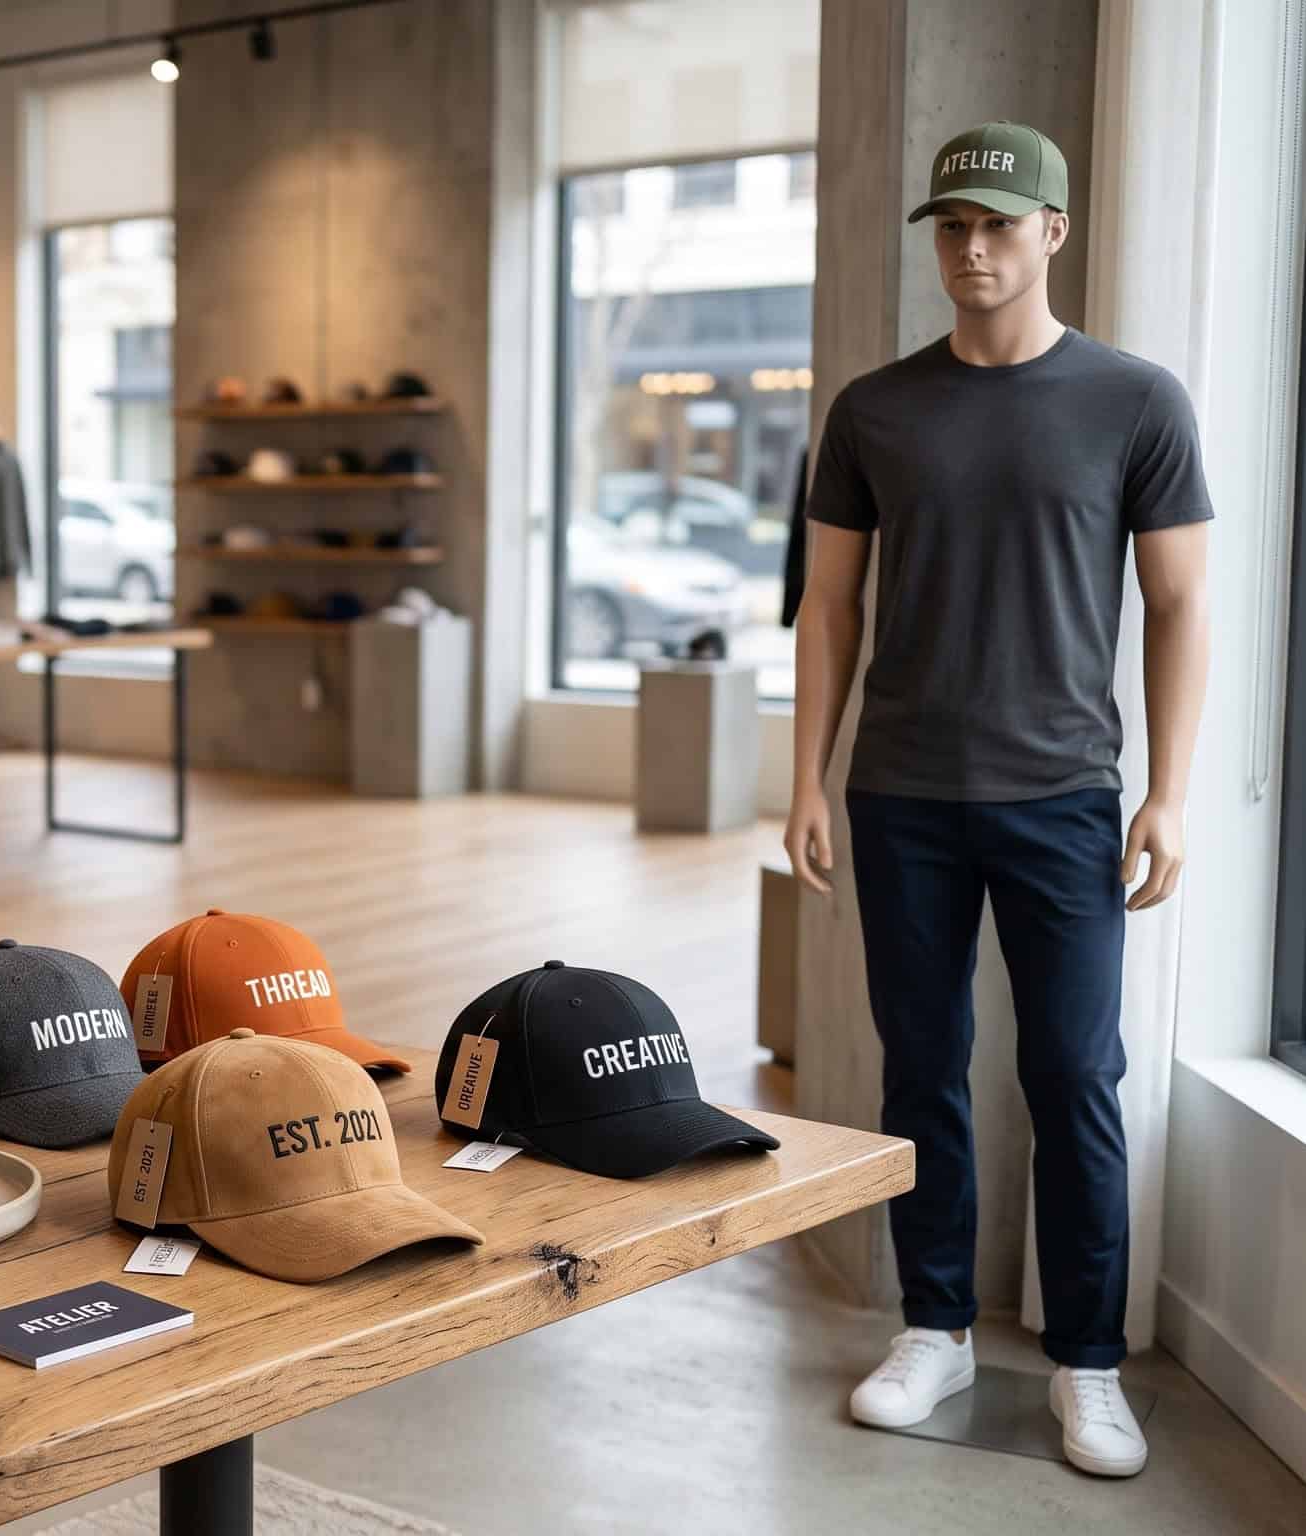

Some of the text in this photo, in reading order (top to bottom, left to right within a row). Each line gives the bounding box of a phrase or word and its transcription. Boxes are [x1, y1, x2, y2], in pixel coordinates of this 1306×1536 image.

[940, 150, 1015, 177] ATELIER
[245, 969, 331, 1008] THREAD
[30, 1008, 128, 1051] MODERN
[583, 1033, 689, 1079] CREATIVE
[267, 1109, 383, 1159] EST. 2021
[18, 1301, 119, 1334] ATELIER
